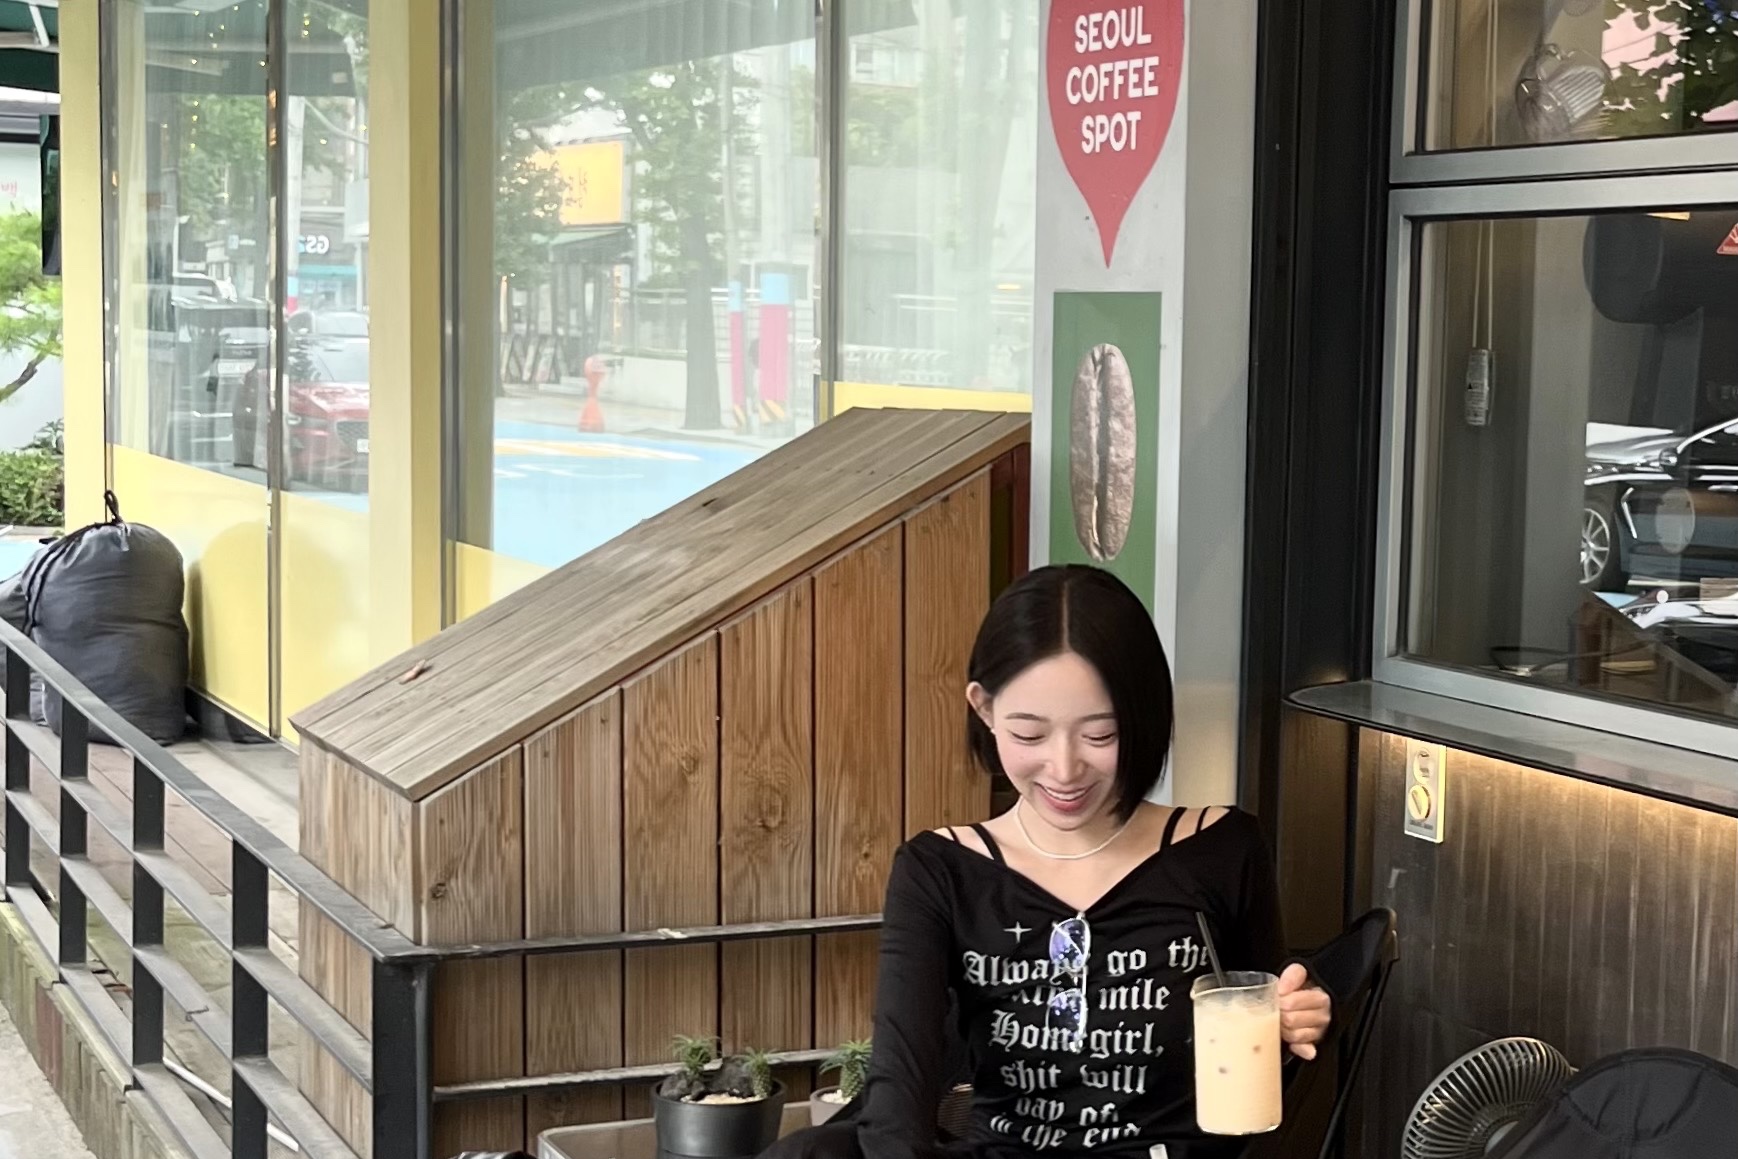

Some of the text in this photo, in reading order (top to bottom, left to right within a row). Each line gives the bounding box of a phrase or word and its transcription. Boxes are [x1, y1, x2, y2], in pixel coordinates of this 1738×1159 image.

[1074, 5, 1152, 53] SEOUL
[1066, 56, 1159, 105] COFFEE
[1081, 111, 1142, 154] SPOT
[1106, 948, 1148, 977] go
[1098, 977, 1171, 1010] mile
[989, 1009, 1164, 1059] Homgirl,
[1000, 1060, 1148, 1095] shit will
[1021, 1123, 1067, 1151] the
